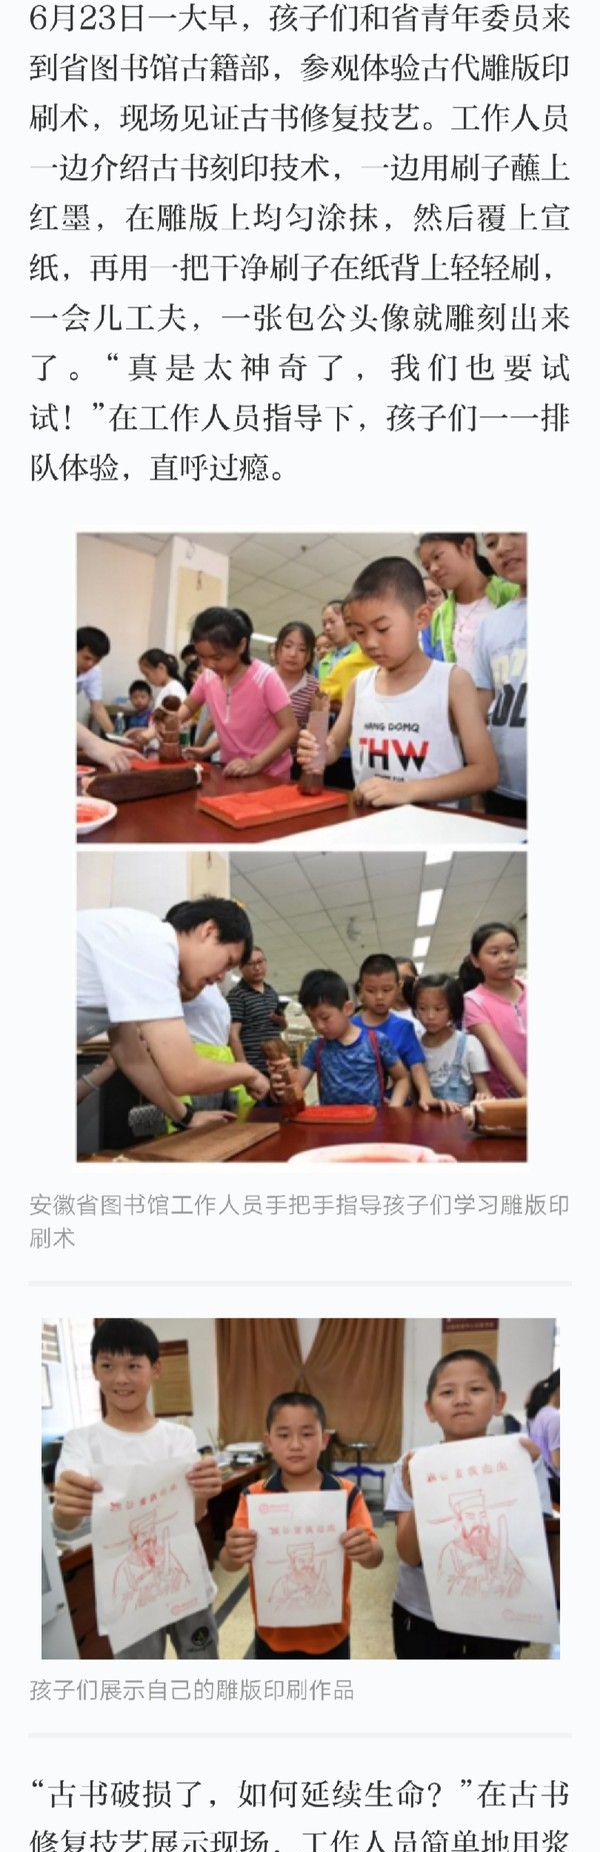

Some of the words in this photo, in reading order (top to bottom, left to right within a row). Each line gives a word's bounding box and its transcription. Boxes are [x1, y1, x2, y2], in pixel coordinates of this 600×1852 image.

[30, 3, 570, 32] 6月23日一大早，孩子们和省青年委员来
[30, 53, 569, 82] 到省图书馆古籍部，参观体验古代雕版印
[29, 103, 568, 132] 刷术，现场见证古书修复技艺。工作人员
[30, 153, 570, 182] 一边介绍古书刻印技术，一边用刷子蘸上
[30, 203, 570, 232] 红墨，在雕版上均匀涂抹，然后覆上宣
[30, 253, 551, 282] 纸，再用一把干净刷子在纸背上轻轻刷，
[30, 303, 570, 332] 一会儿工夫，一张包公头像就雕刻出来
[30, 402, 570, 432] 试！”在工作人员指导下，孩子们一一排
[32, 453, 281, 481] 队体验，直呼过瘾。
[30, 1194, 568, 1216] 安徽省图书馆工作人员手把手指导孩子们学习雕版印
[30, 1227, 75, 1248] 刷术
[30, 1679, 353, 1700] 孩子们展示自己的雕版印刷作品
